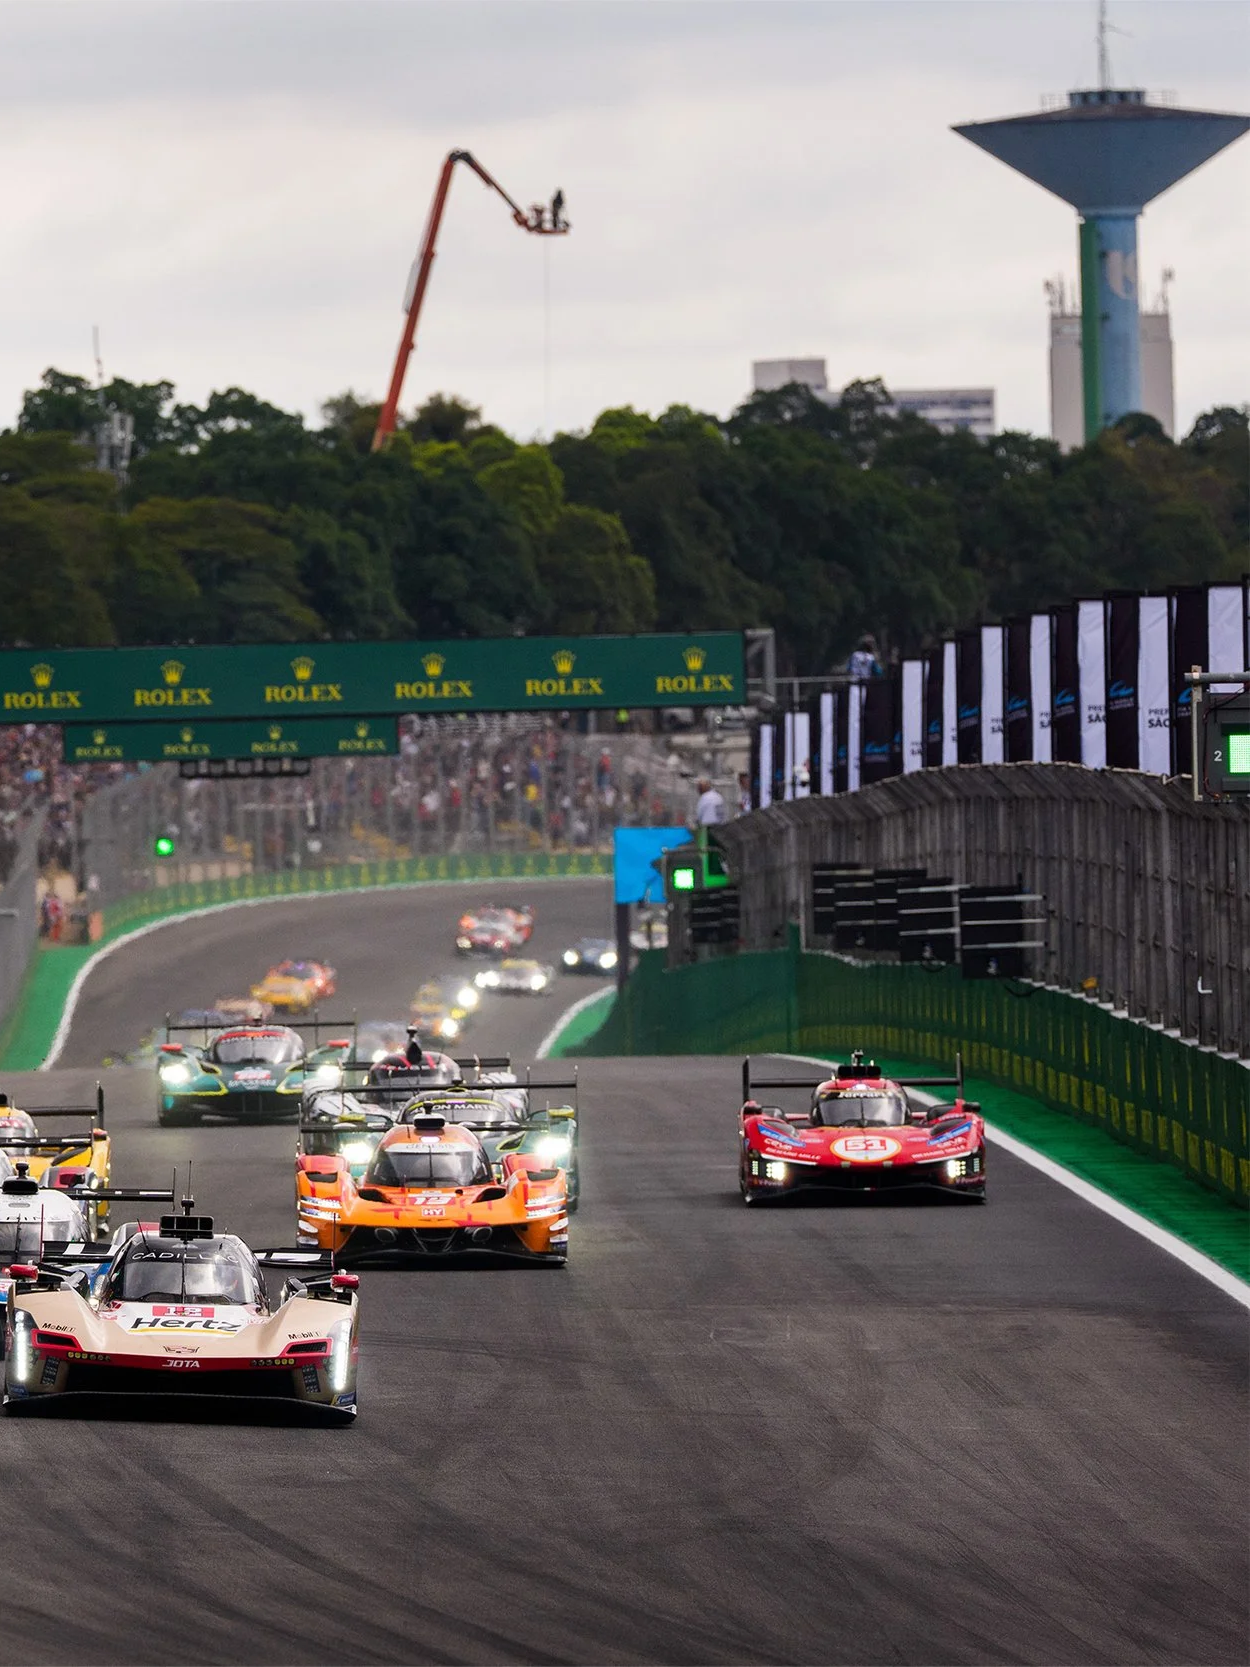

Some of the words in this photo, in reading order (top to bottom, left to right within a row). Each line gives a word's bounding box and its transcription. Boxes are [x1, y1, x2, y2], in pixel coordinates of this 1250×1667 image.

[394, 680, 473, 699] ROLEX
[525, 677, 604, 696] ROLEX
[655, 674, 734, 694] ROLEX
[133, 687, 212, 707] ROLEX
[265, 683, 343, 702] ROLEX
[4, 691, 82, 709] ROLEX
[162, 743, 211, 756] ROLEX
[251, 740, 299, 753] ROLEX
[338, 738, 386, 751] ROLEX
[75, 745, 123, 758] ROLEX
[1214, 750, 1223, 762] 2
[846, 1140, 886, 1150] 51
[423, 1208, 443, 1216] HY
[131, 1252, 239, 1263] CADILLAC
[164, 1306, 202, 1317] 12
[42, 1322, 68, 1332] Mobil
[131, 1317, 242, 1332] Hertz
[288, 1331, 314, 1340] Mobil
[161, 1359, 201, 1368] JOTA
